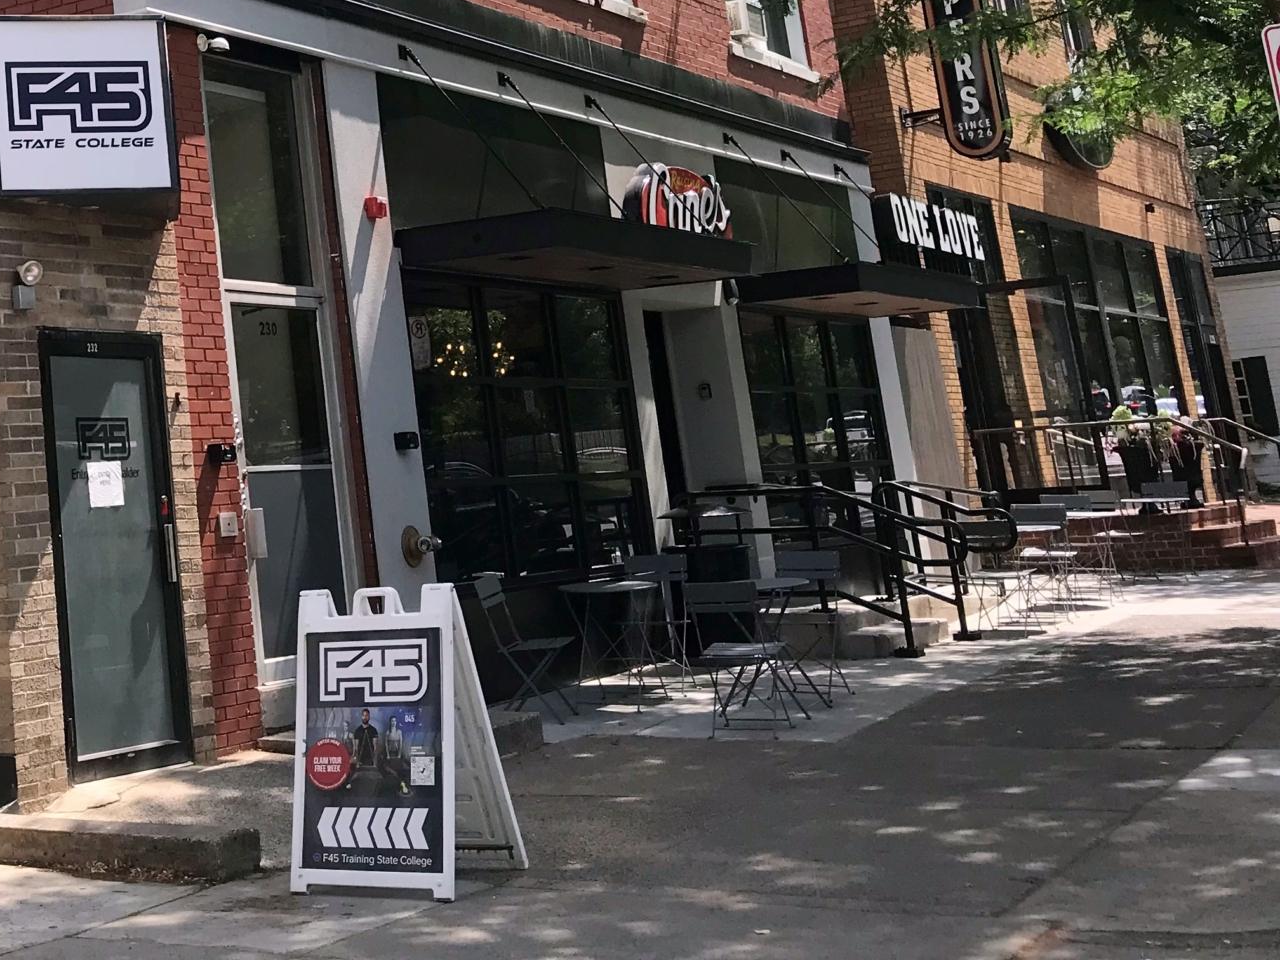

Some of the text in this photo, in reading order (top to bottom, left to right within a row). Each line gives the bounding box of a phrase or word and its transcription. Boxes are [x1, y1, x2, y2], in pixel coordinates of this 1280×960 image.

[5, 61, 152, 133] F45
[958, 118, 992, 132] SINCE
[960, 128, 993, 141] 1926
[10, 137, 155, 150] STATE COLLEGE
[889, 192, 986, 261] ONE LOVE
[259, 321, 278, 336] 230
[86, 342, 98, 353] 232
[76, 417, 130, 460] F45
[319, 638, 428, 702] F45
[313, 756, 342, 765] CLAIM YOUR
[314, 764, 341, 773] FREE WEEK
[322, 853, 433, 868] F45 Training State College
